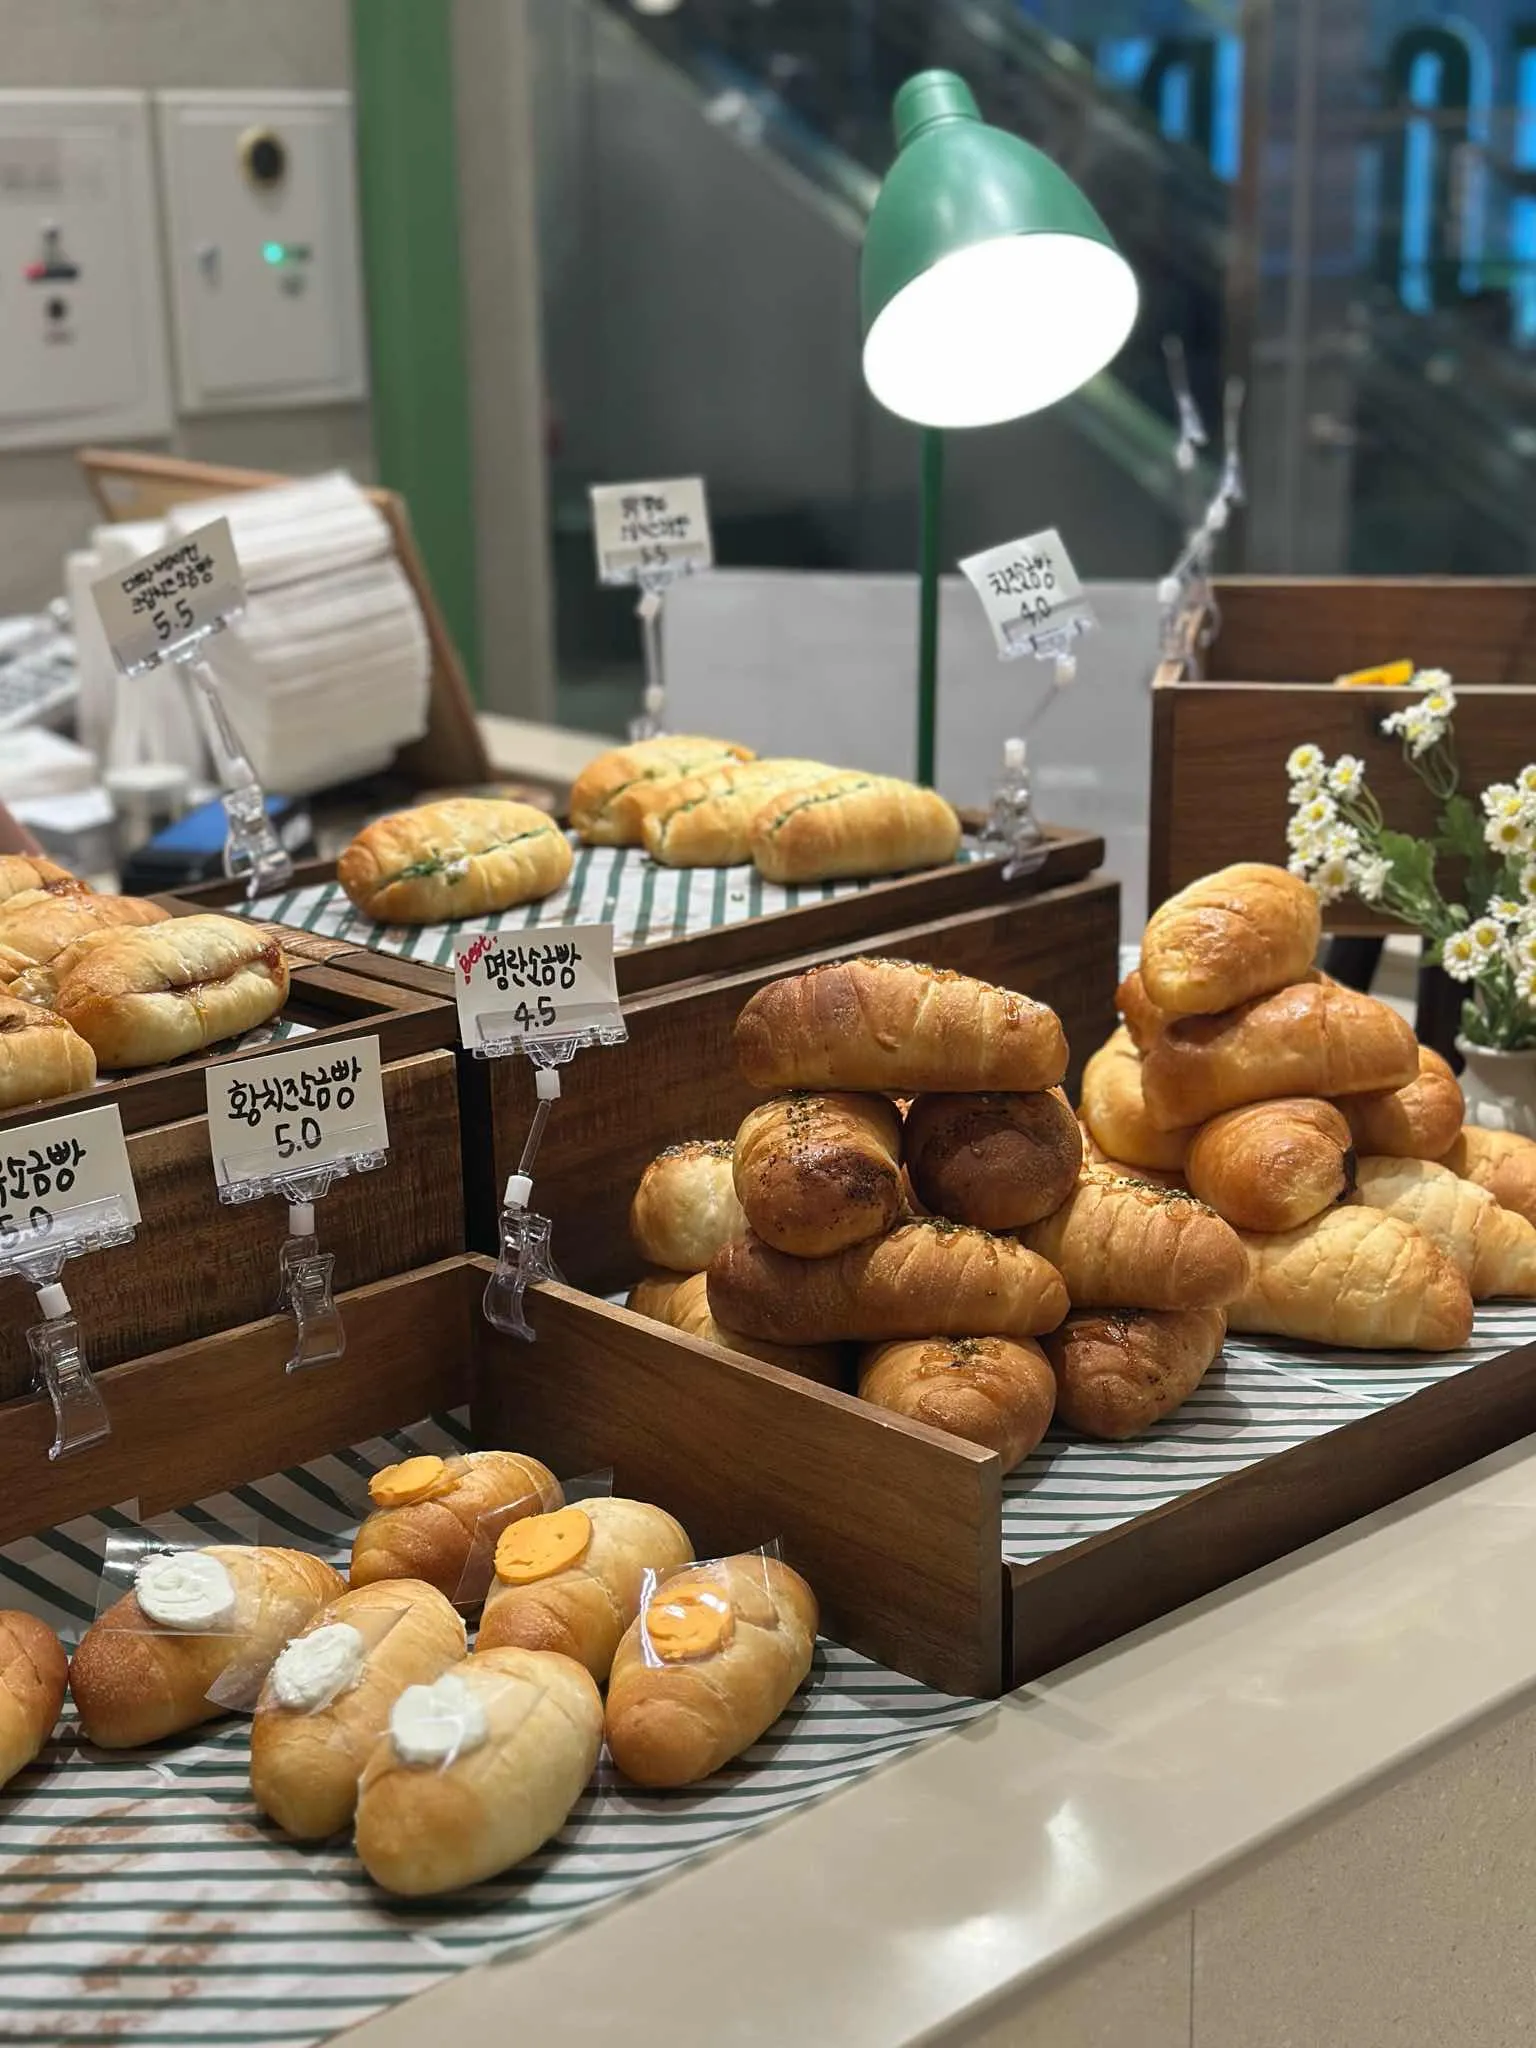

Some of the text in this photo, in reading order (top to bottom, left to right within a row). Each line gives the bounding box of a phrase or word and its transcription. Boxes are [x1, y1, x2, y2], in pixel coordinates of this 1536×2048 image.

[152, 598, 194, 640] 5.5
[484, 942, 582, 991] 명란소금빵
[514, 996, 557, 1032] 4.5
[228, 1056, 362, 1127] 황치즈소금빵
[275, 1117, 322, 1159] 5.0
[0, 1138, 87, 1208] 소금빵
